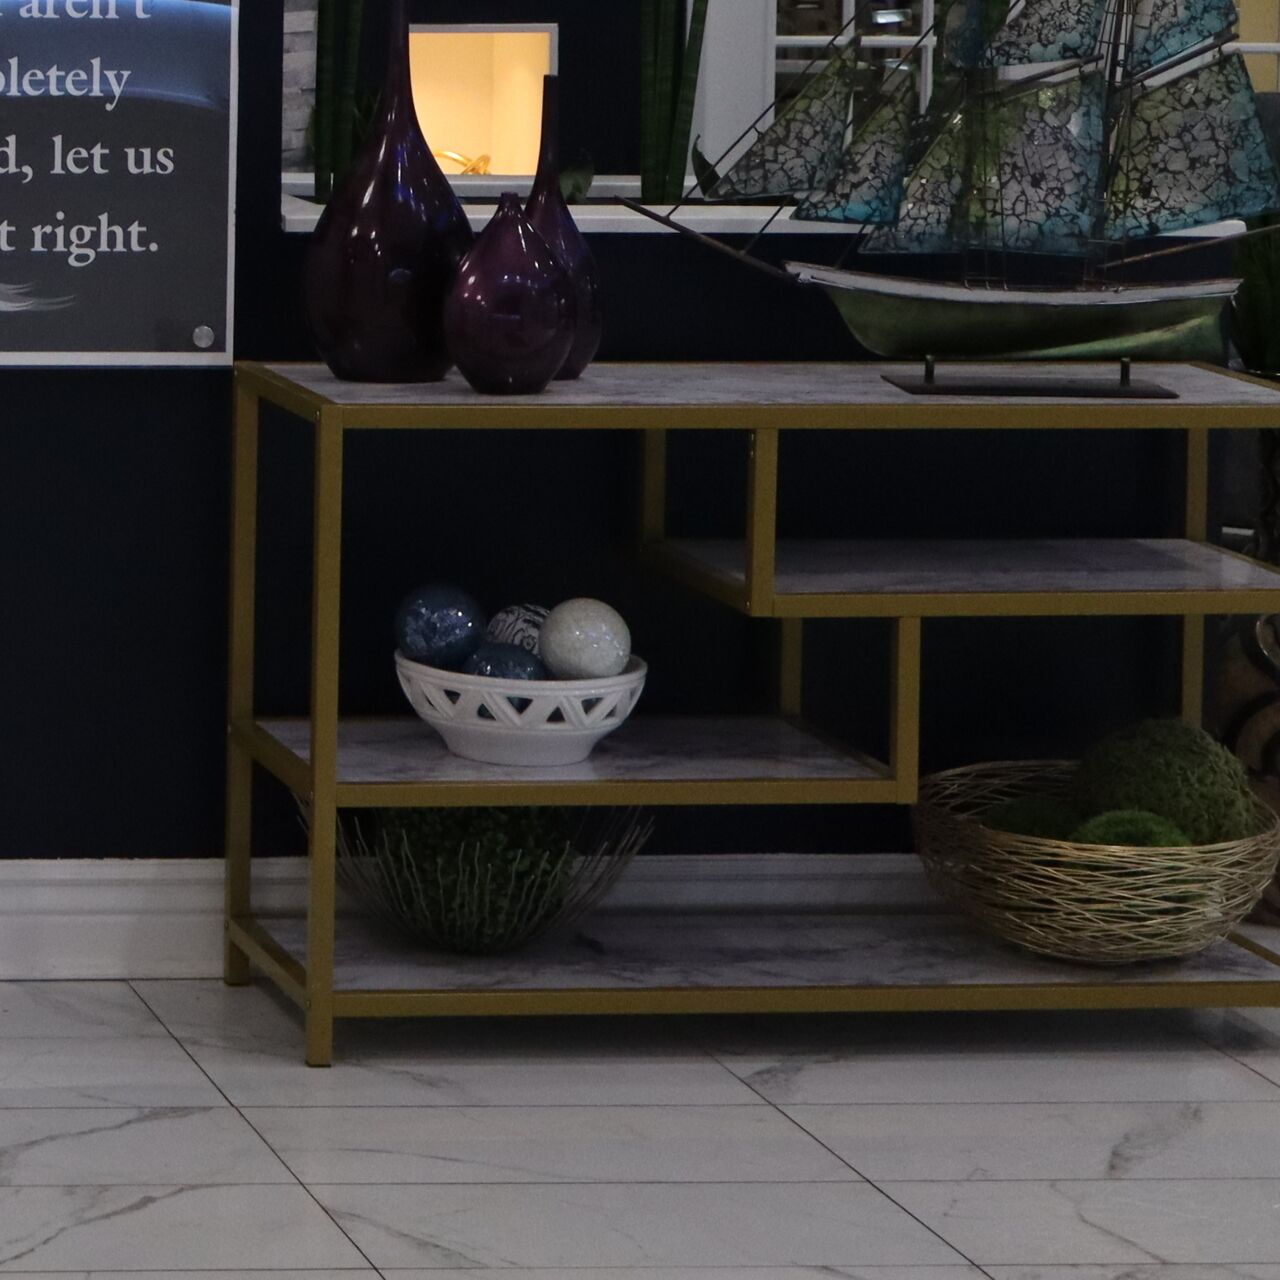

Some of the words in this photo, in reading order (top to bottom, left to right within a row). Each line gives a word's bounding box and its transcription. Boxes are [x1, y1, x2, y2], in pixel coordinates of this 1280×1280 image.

[51, 135, 110, 176] let
[124, 148, 175, 176] us
[30, 210, 160, 268] right.
